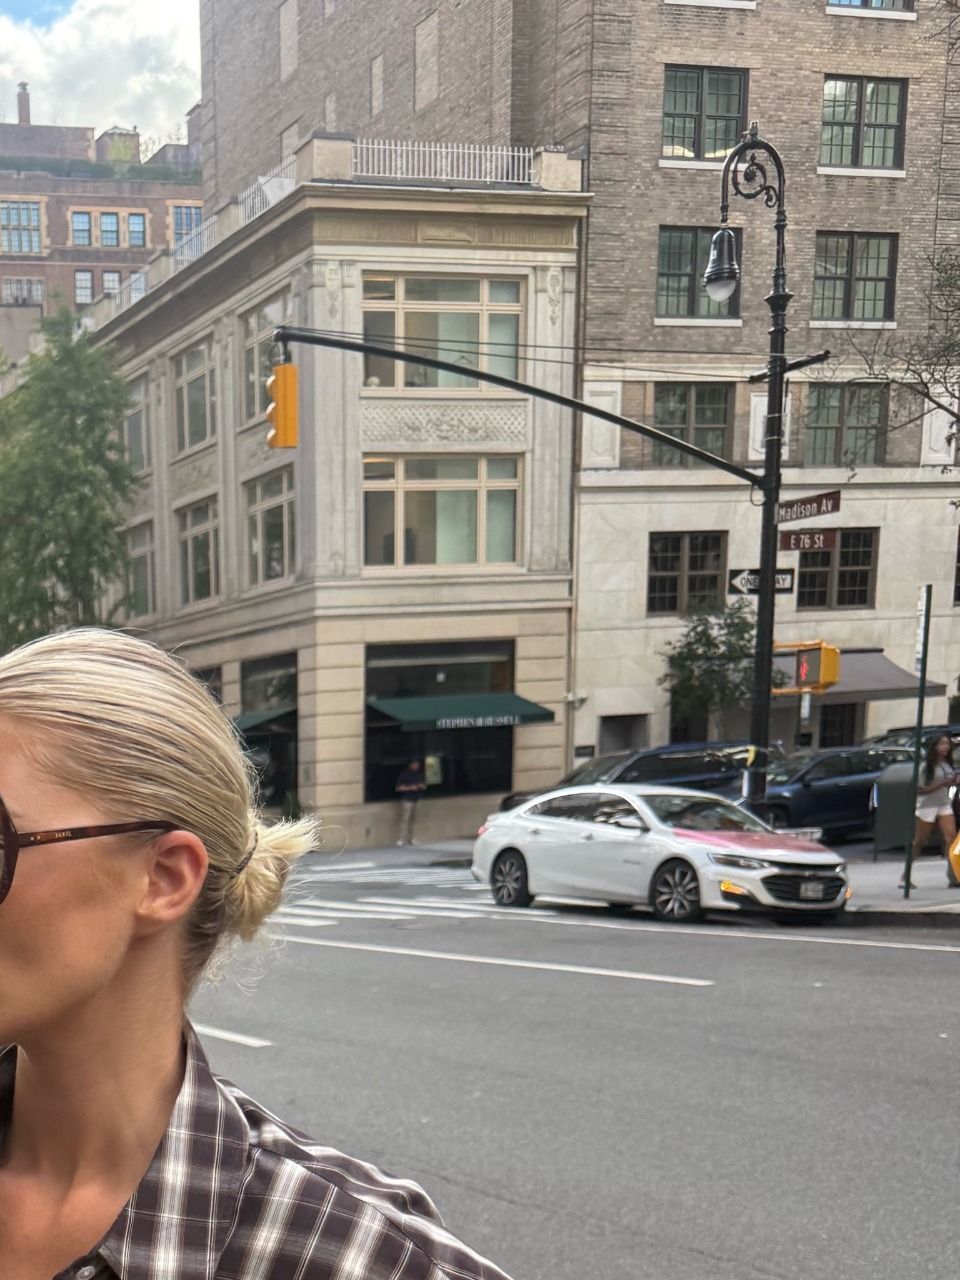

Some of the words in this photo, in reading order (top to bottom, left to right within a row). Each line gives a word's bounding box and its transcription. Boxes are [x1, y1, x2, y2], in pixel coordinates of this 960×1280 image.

[779, 503, 818, 521] Madison
[821, 498, 833, 513] Av
[790, 534, 797, 549] E
[800, 534, 811, 549] 76
[813, 533, 824, 549] St
[436, 718, 475, 729] STEPHEN
[484, 715, 520, 727] RUSSELL
